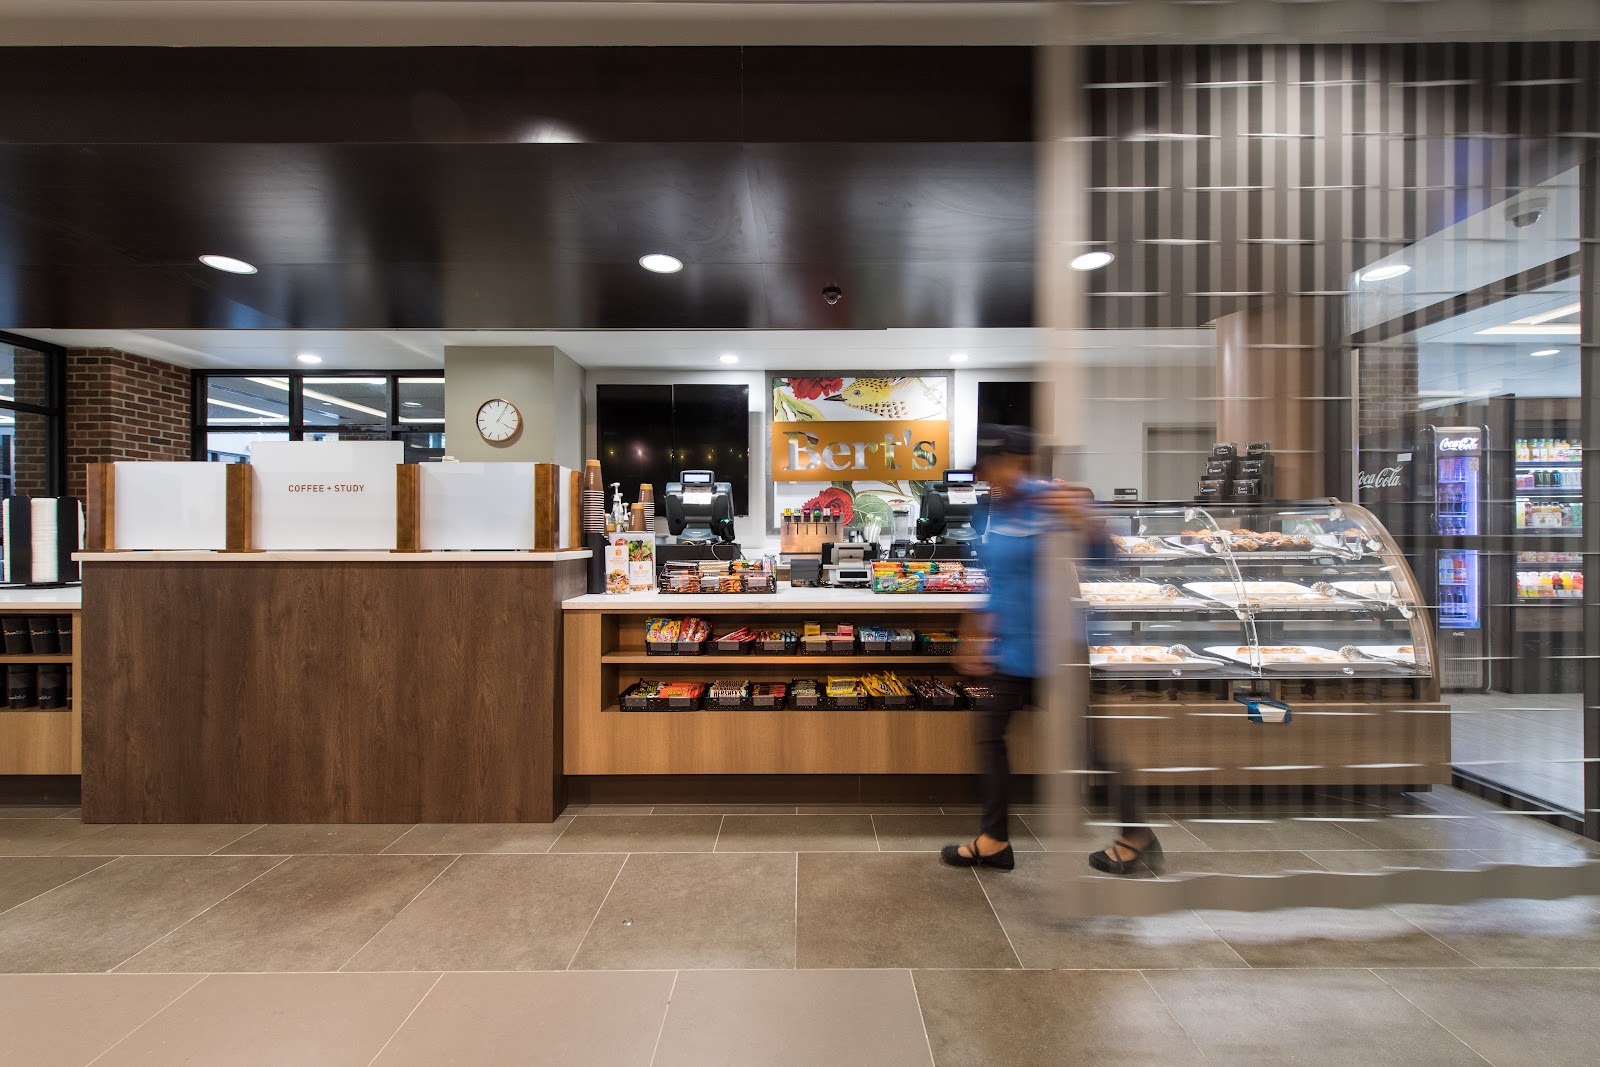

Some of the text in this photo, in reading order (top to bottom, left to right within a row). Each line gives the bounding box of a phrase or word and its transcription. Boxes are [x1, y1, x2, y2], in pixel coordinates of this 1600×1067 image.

[783, 428, 937, 471] Bert's
[288, 484, 324, 492] COFFEE
[334, 484, 365, 492] STUDY
